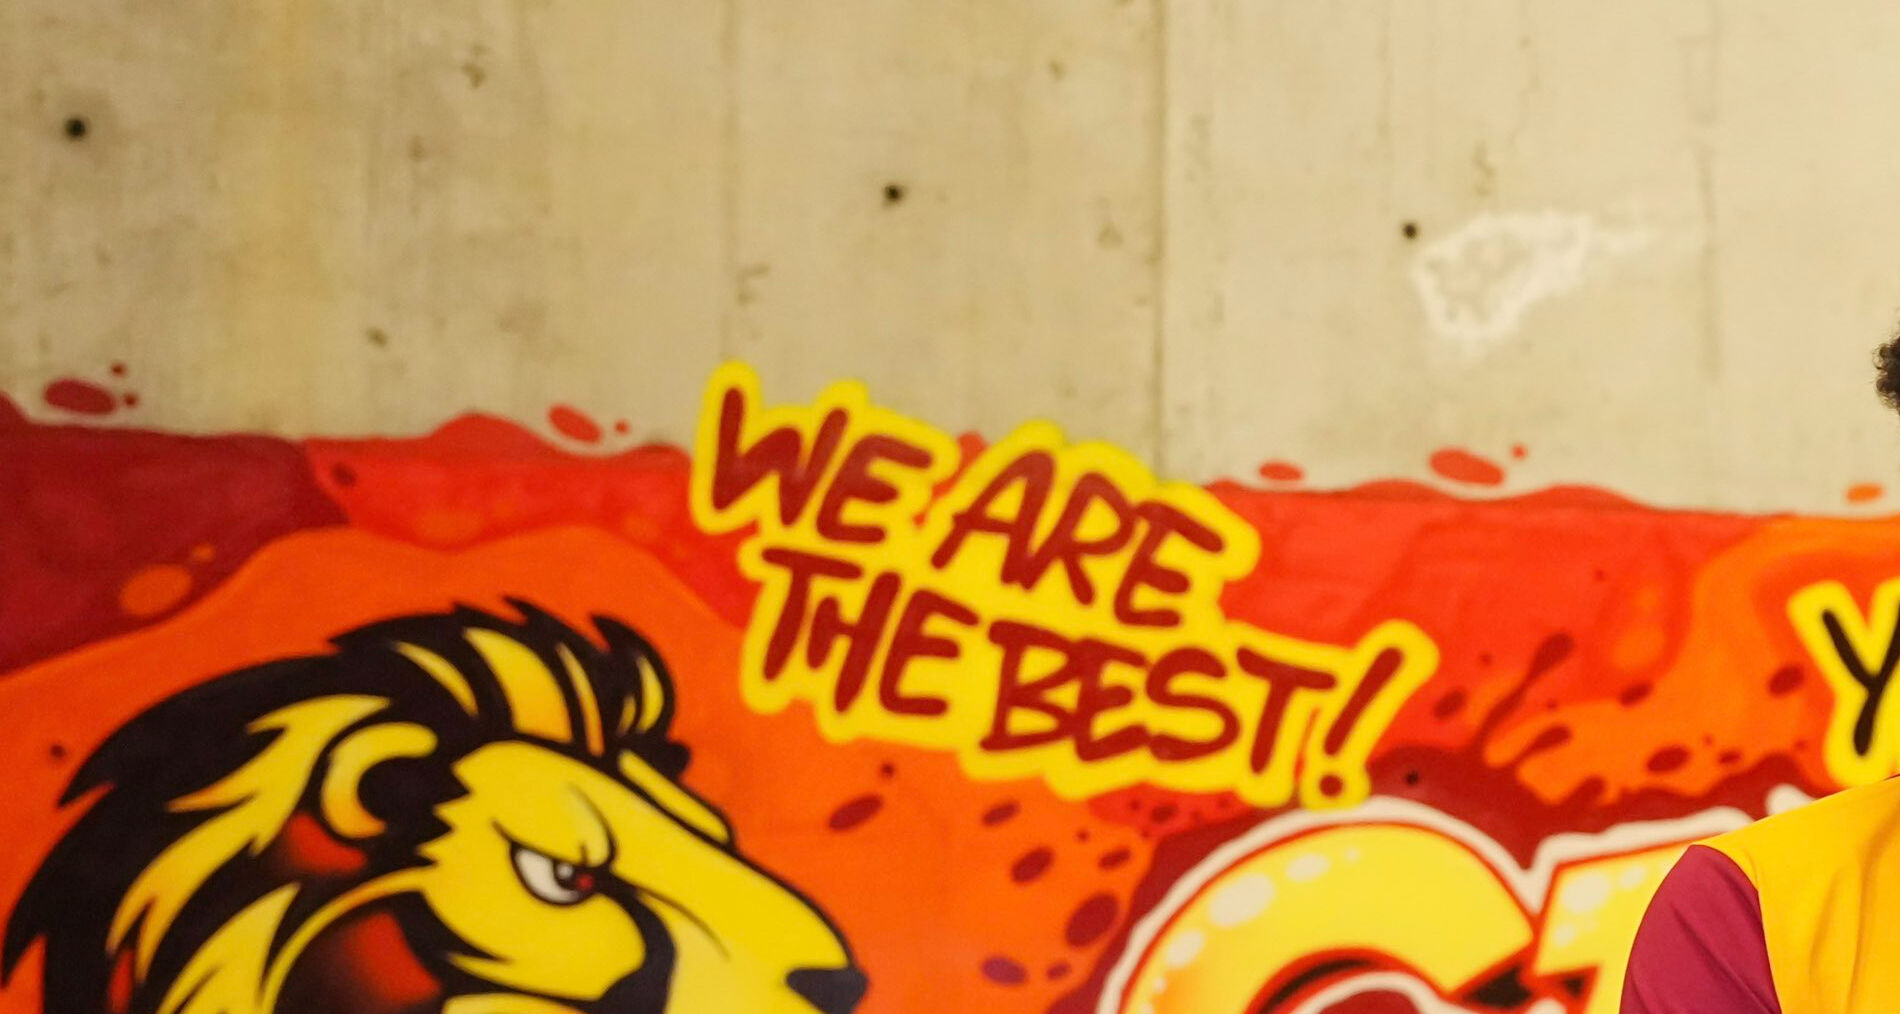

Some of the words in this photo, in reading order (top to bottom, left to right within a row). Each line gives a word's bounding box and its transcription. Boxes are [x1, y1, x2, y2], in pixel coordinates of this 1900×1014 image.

[713, 386, 933, 546] WE
[930, 448, 1226, 628] ARE
[762, 547, 980, 717] THE
[979, 618, 1404, 799] BEST!
